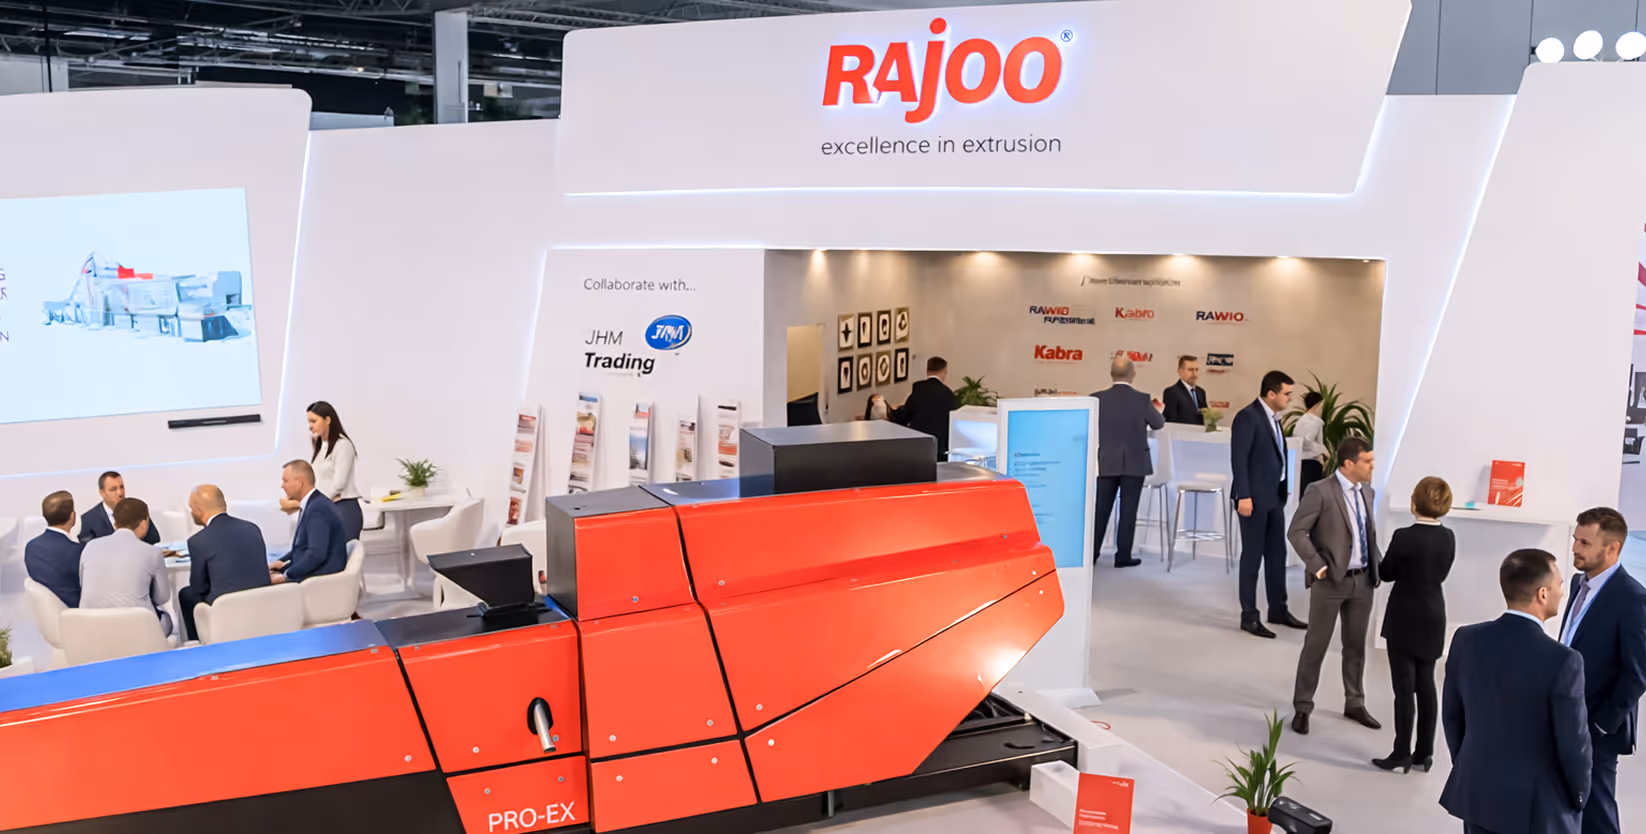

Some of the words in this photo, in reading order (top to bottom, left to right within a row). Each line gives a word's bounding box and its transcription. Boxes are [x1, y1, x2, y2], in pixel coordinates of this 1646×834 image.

[821, 136, 931, 155] excellence
[937, 135, 955, 153] in
[962, 133, 1062, 153] extrusion
[583, 278, 655, 290] Collaborate
[1196, 310, 1244, 322] RAWIO
[585, 329, 623, 345] JHM
[1034, 345, 1083, 360] Kabra
[584, 351, 656, 375] Trading
[488, 800, 575, 832] PRO-EX
